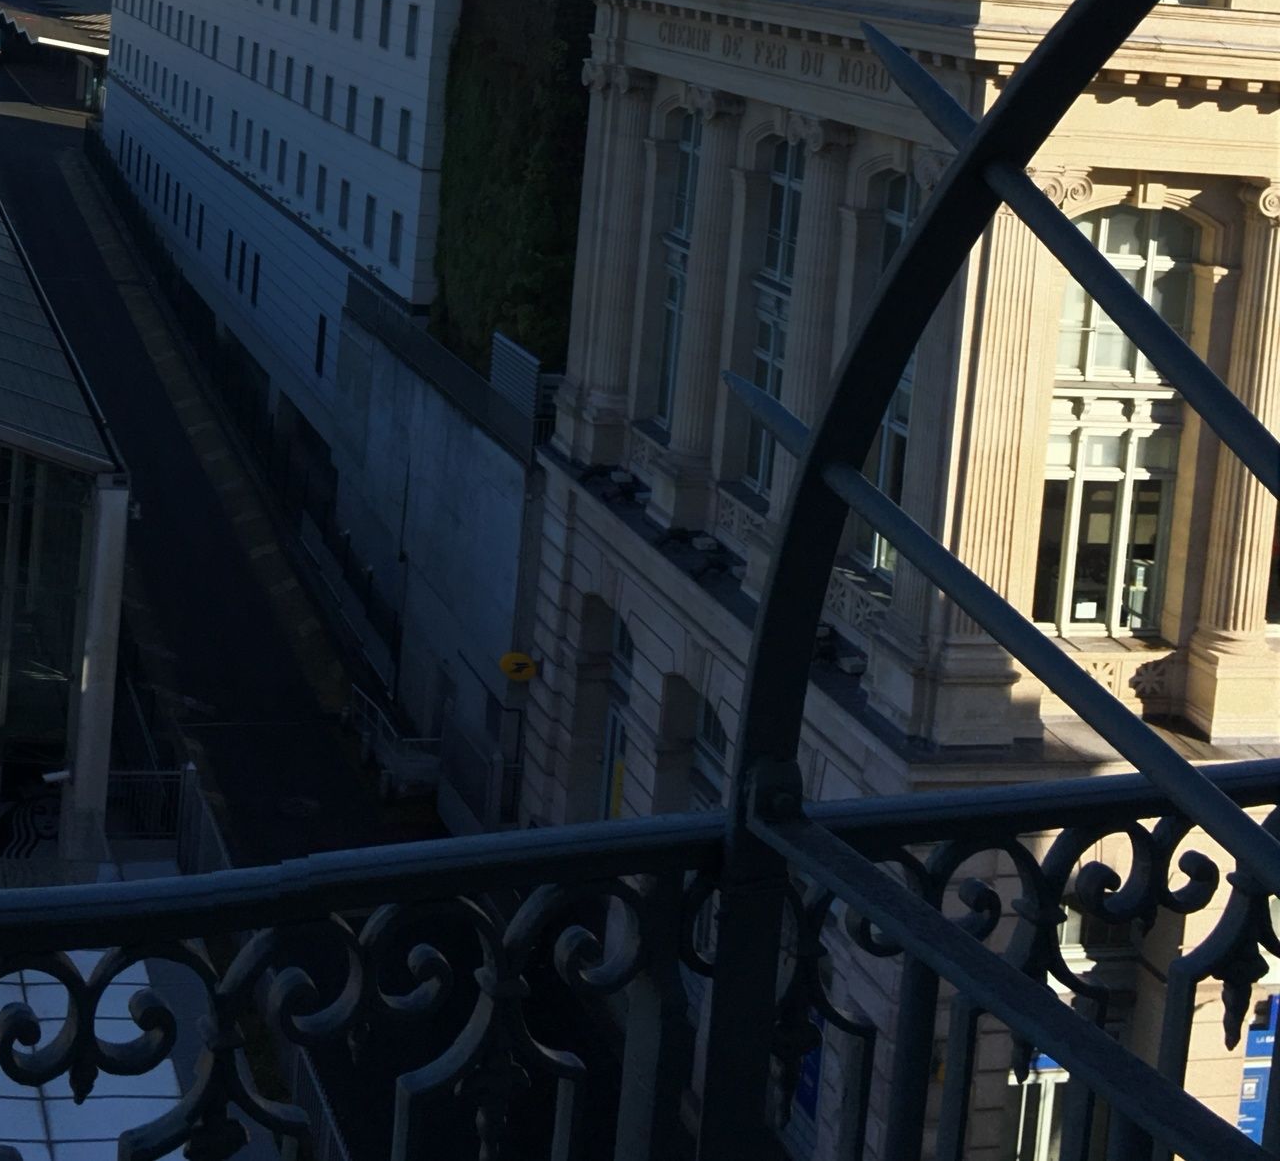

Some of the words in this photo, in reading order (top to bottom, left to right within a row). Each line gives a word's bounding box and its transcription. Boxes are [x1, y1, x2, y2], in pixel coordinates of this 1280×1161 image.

[658, 20, 712, 53] CHEMIN
[721, 33, 744, 62] DE
[753, 39, 787, 71] FER
[800, 48, 825, 79] DU
[837, 56, 891, 93] NORD
